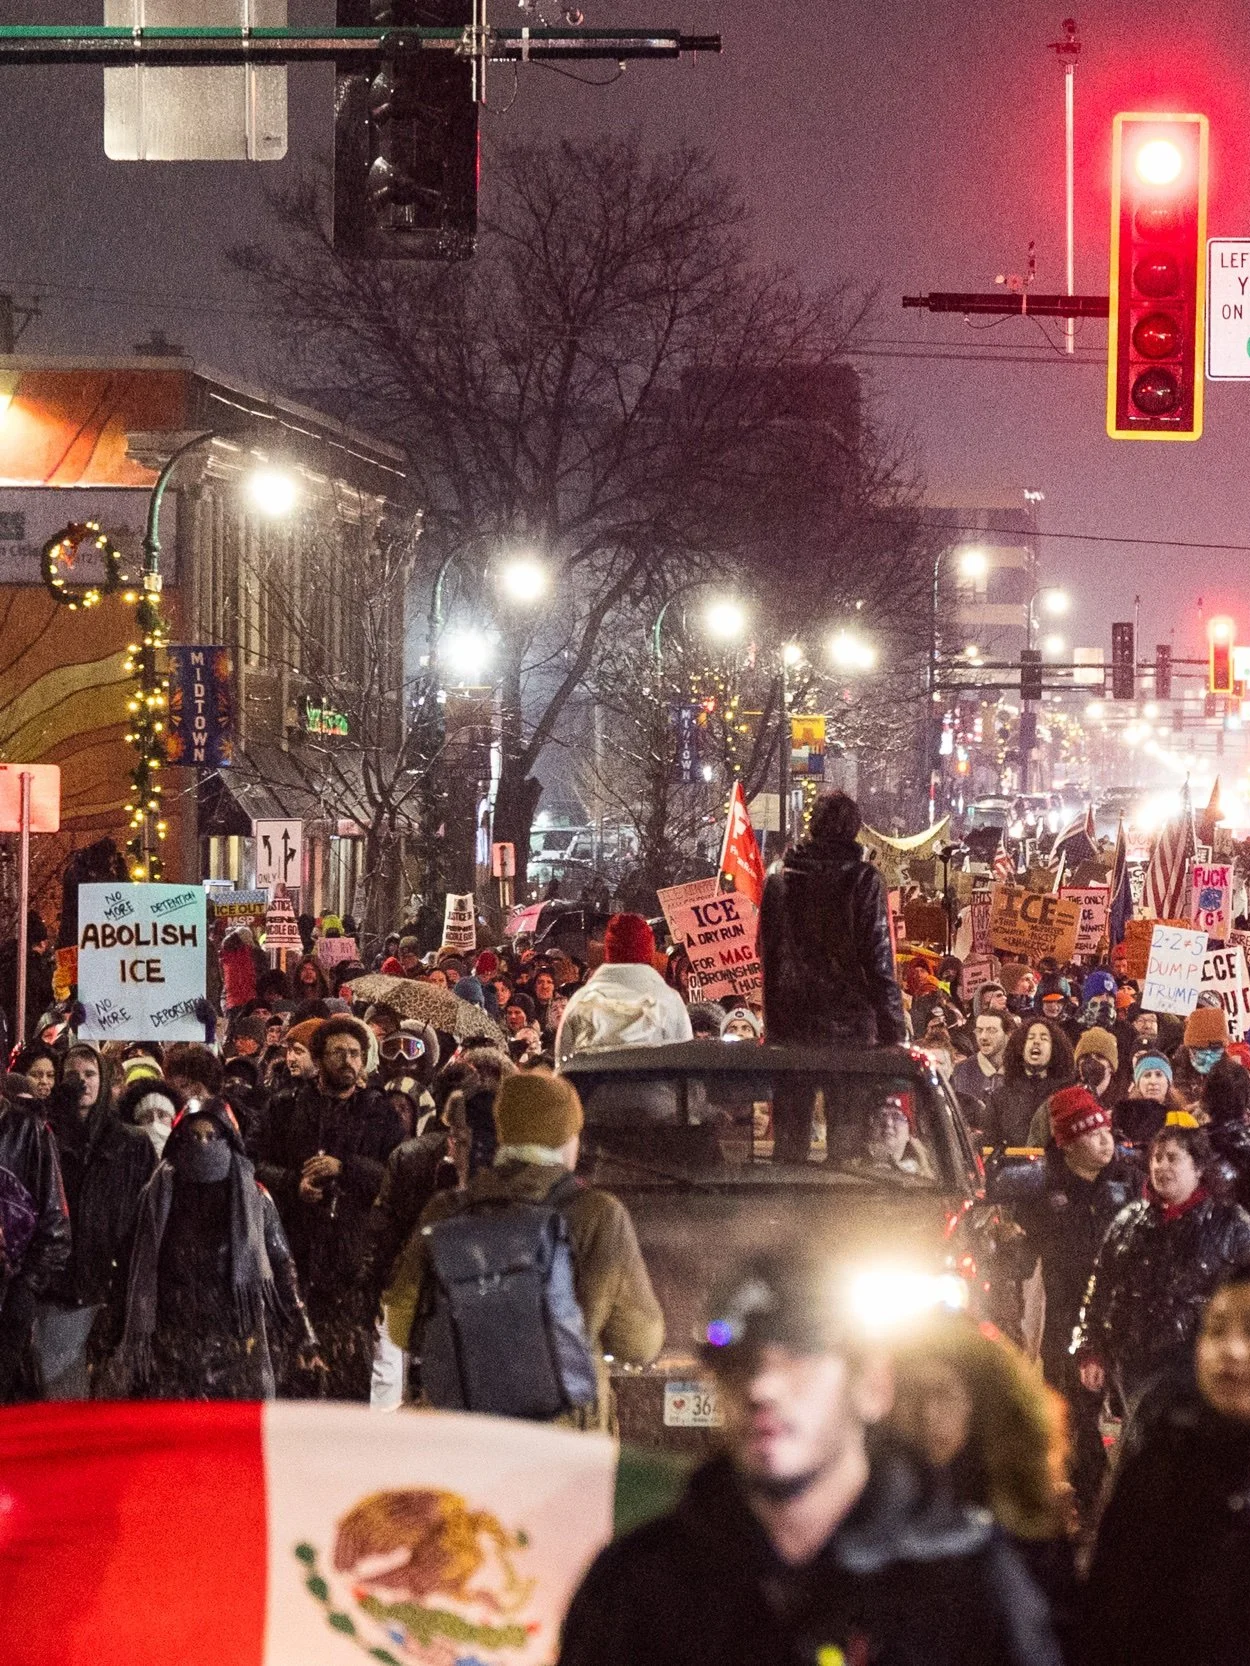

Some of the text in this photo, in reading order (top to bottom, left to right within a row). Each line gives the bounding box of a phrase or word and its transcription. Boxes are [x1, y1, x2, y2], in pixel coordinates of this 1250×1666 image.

[1222, 304, 1243, 319] ON
[189, 651, 206, 762] MIDTOWN
[258, 873, 277, 884] ONLY
[1193, 866, 1229, 887] FUCK
[104, 891, 123, 904] NO
[149, 890, 196, 914] DETENTION
[1000, 885, 1058, 925] ICE
[1084, 895, 1106, 906] ONLY
[103, 901, 135, 921] MORE
[216, 903, 264, 916] ICE OUT
[691, 897, 740, 928] ICE
[80, 921, 198, 950] ABOLISH
[686, 922, 745, 949] A DRY RUN
[119, 957, 166, 983] ICE
[692, 956, 717, 974] FOR
[699, 961, 762, 986] BROWNSHIR
[1148, 957, 1198, 980] DUMP
[1200, 952, 1238, 982] ICE
[729, 975, 764, 995] THUG
[1146, 981, 1198, 1006] TRUMP
[95, 999, 113, 1015] NO
[97, 1007, 131, 1031] MORE
